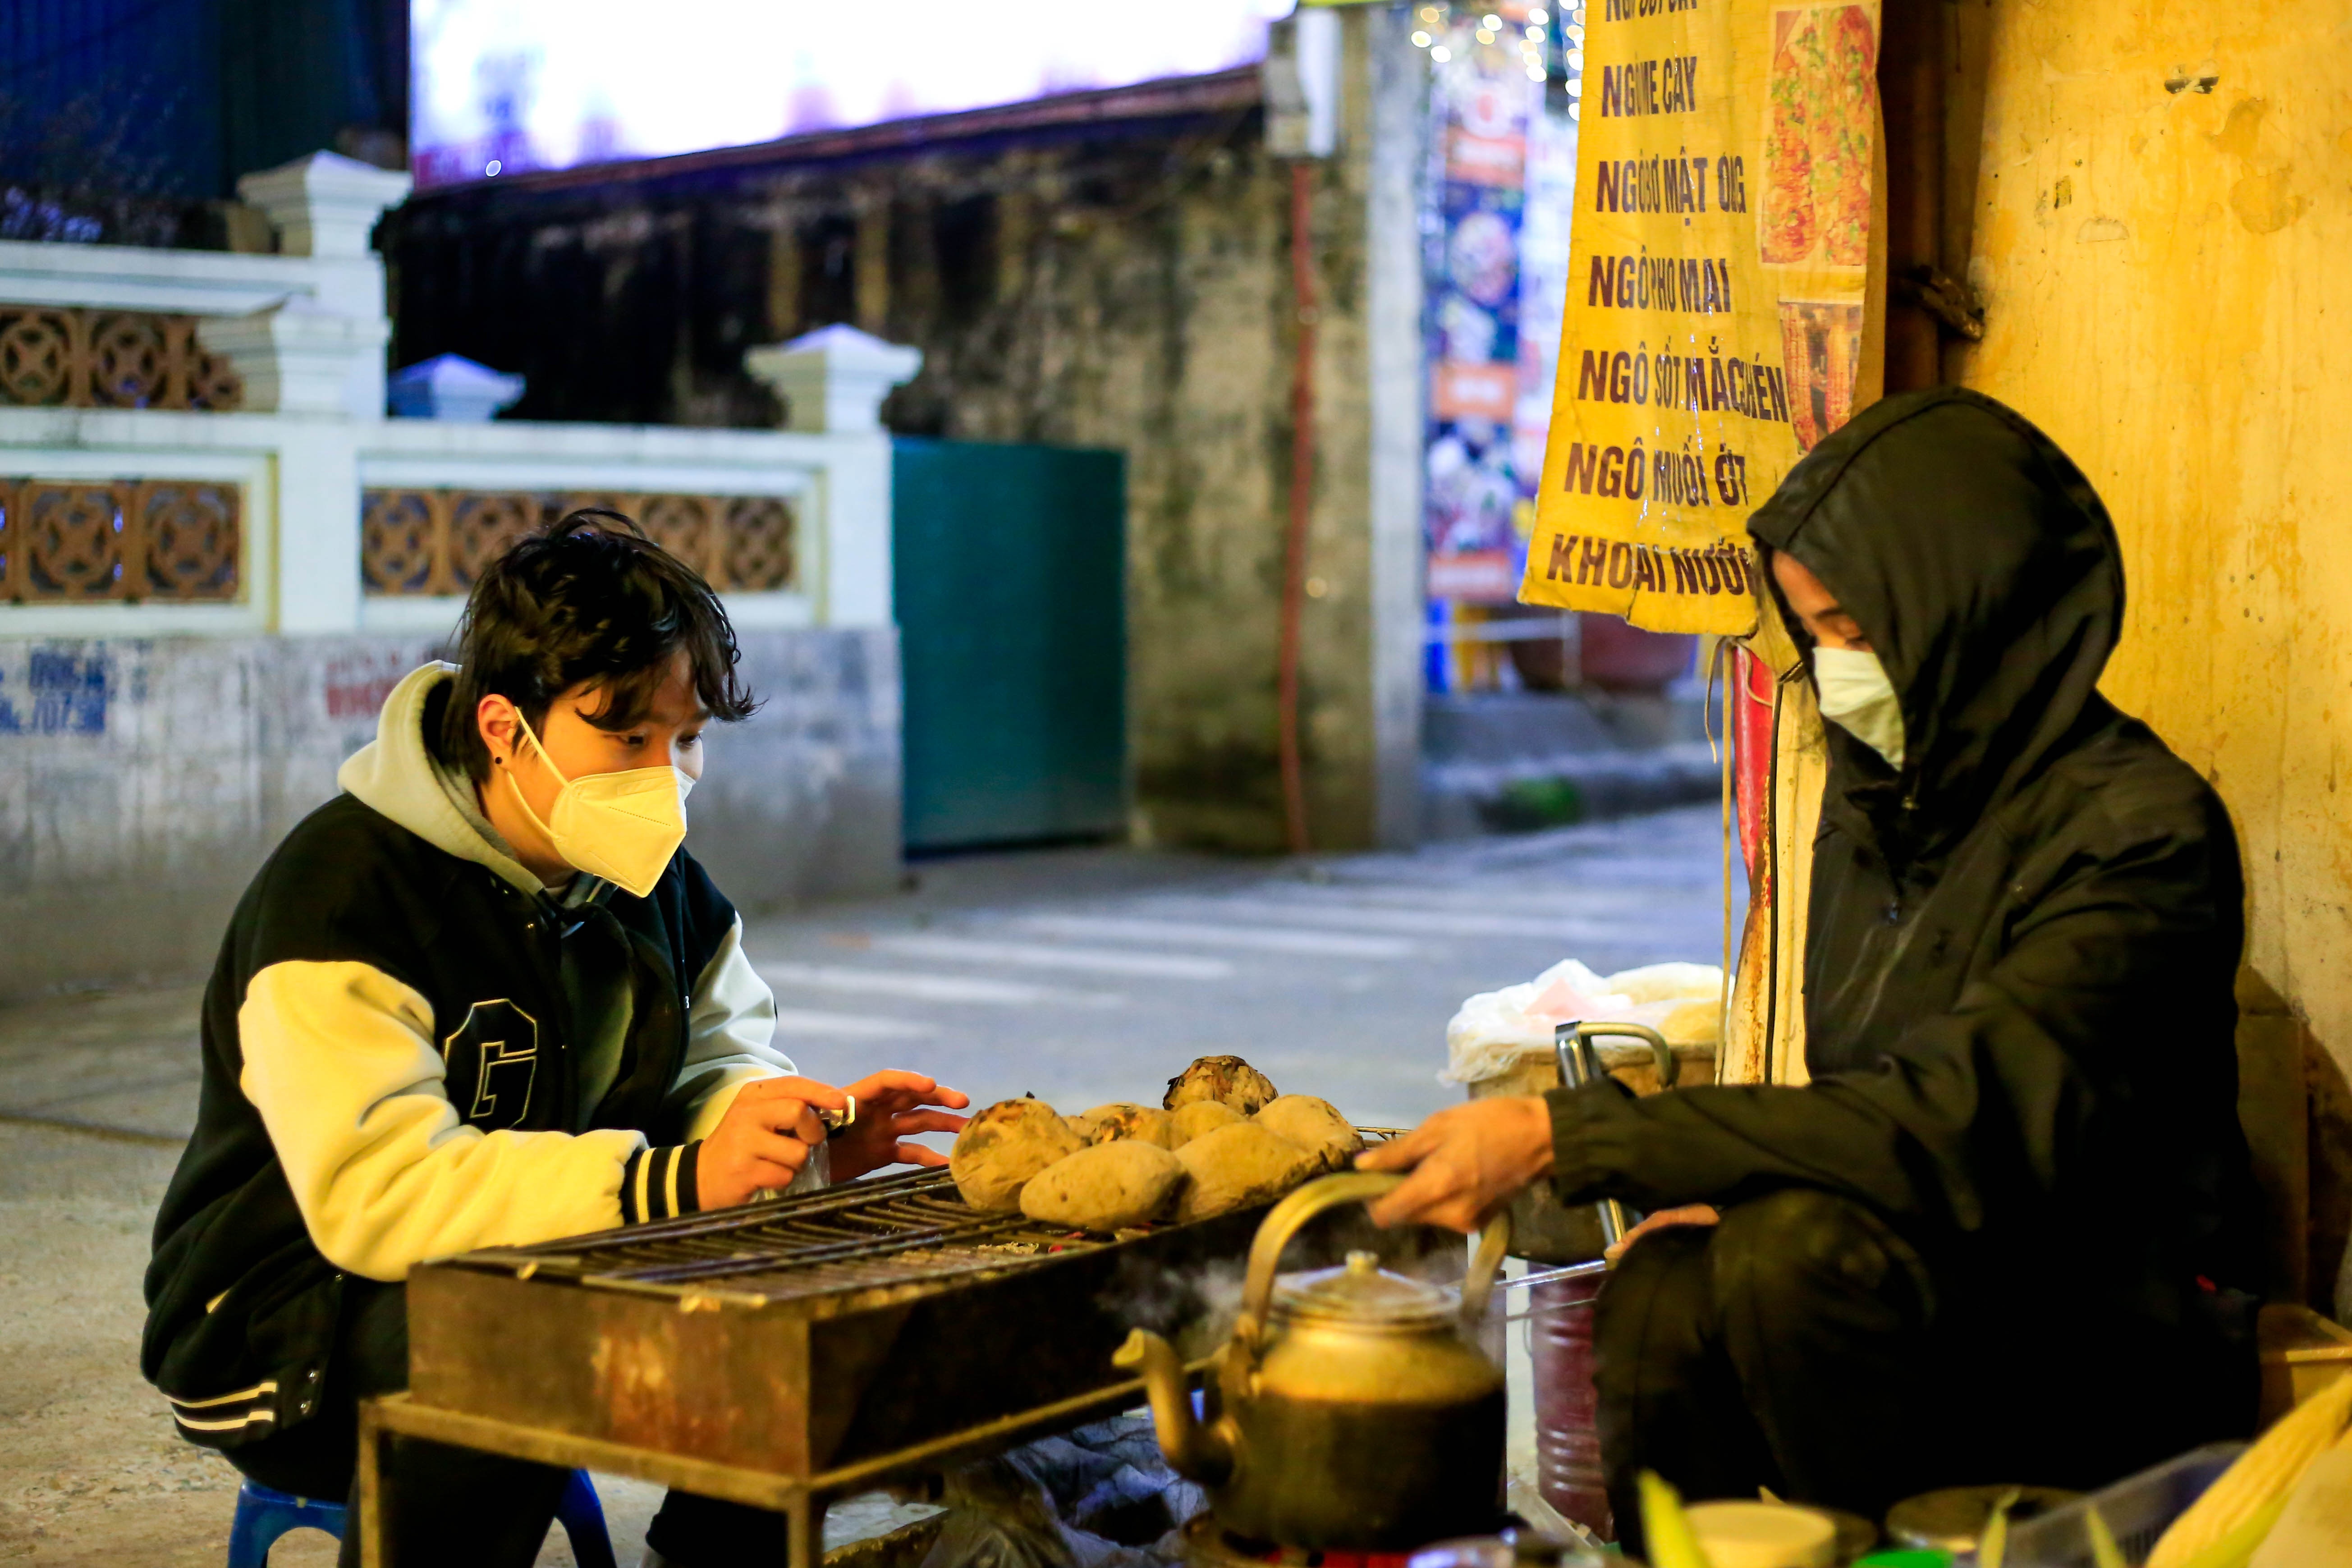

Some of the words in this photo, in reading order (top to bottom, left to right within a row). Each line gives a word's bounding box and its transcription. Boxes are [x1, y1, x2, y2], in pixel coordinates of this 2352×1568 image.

[1663, 56, 1697, 114] CAY
[1664, 145, 1708, 226] MẬT
[1588, 245, 1649, 310] NGÔ
[1650, 257, 1676, 312] PHO
[1679, 258, 1731, 312] MAI
[1578, 341, 1649, 405] NGÔ
[1655, 335, 1680, 409] SỐT
[1564, 436, 1645, 500] NGÔ
[1653, 435, 1710, 507] MUỐI
[1715, 443, 1748, 506] ỚT
[1547, 534, 1666, 593] KHOAI
[443, 998, 537, 1130] G
